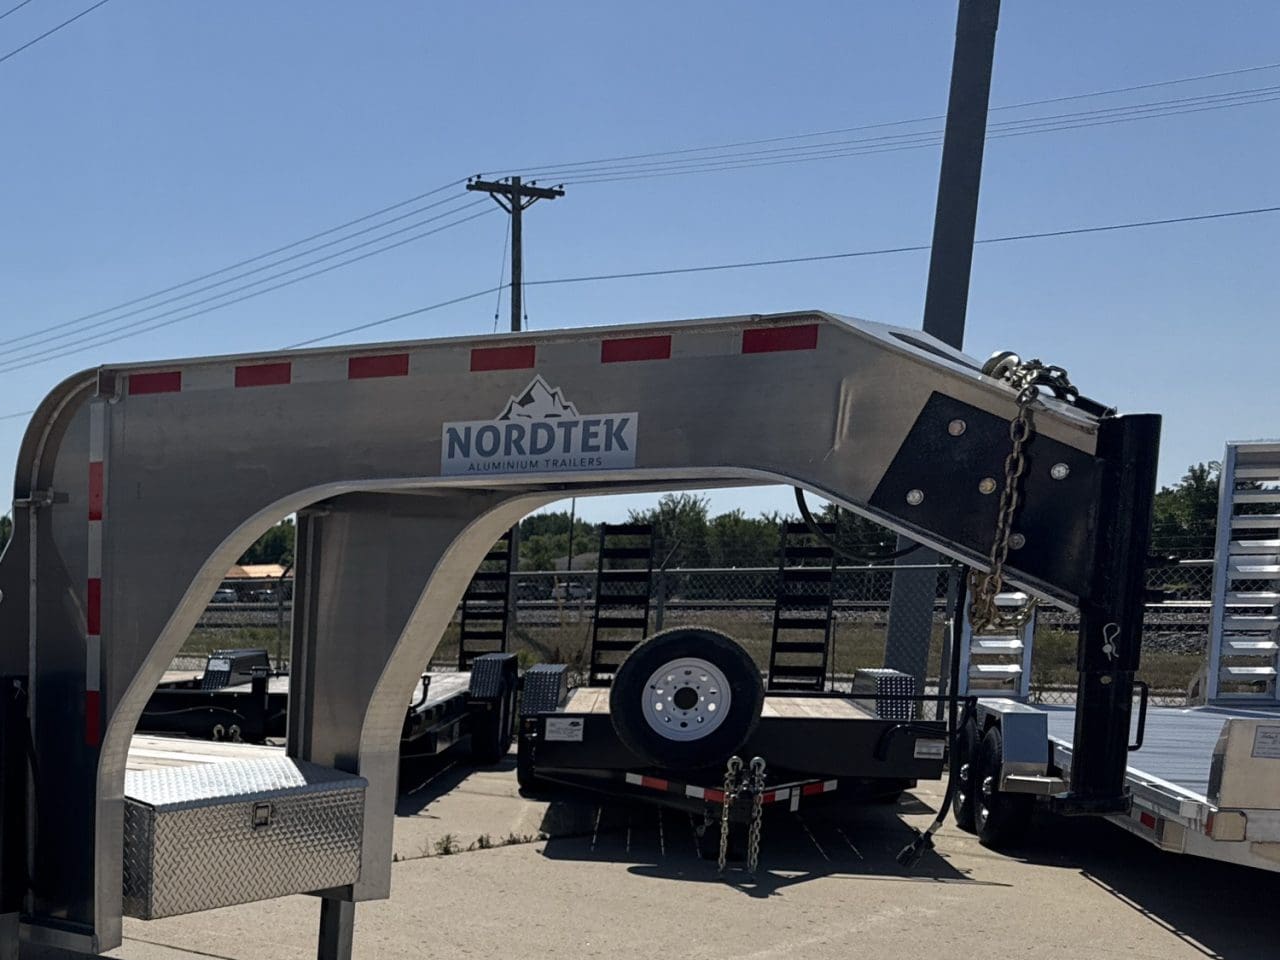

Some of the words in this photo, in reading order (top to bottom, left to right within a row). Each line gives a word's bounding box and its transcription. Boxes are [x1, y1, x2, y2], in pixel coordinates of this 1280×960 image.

[446, 418, 630, 459] NORDTEK
[468, 459, 539, 472] ALUMINIUM
[544, 457, 603, 469] TRAILERS
